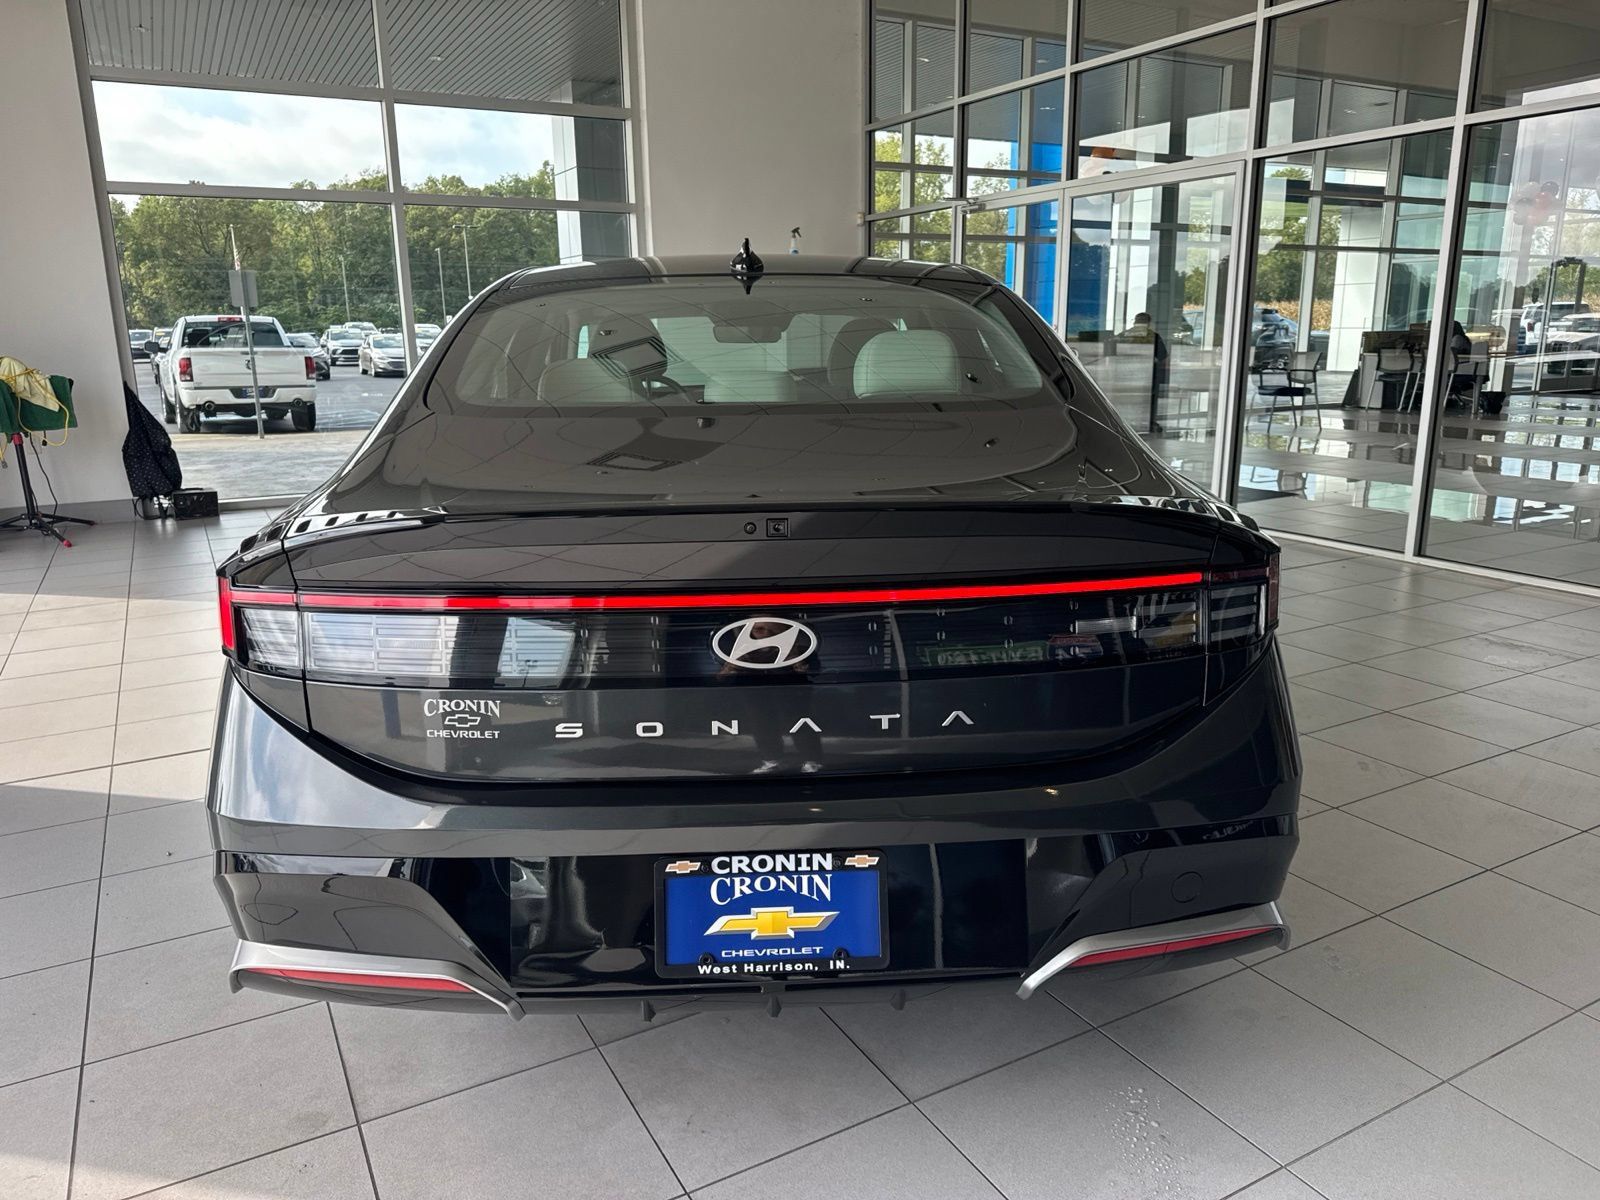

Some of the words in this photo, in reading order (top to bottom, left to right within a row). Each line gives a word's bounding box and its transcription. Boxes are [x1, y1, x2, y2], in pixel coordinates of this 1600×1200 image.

[423, 698, 501, 718] CRONIN
[426, 729, 501, 739] CHEVROLET
[554, 709, 975, 739] SONATA
[711, 853, 833, 875] CRONIN
[710, 874, 833, 906] CRONIN
[721, 946, 824, 958] CHEVROLET
[697, 964, 738, 975] West
[743, 961, 819, 973] Harrison,
[829, 959, 851, 970] IN.
